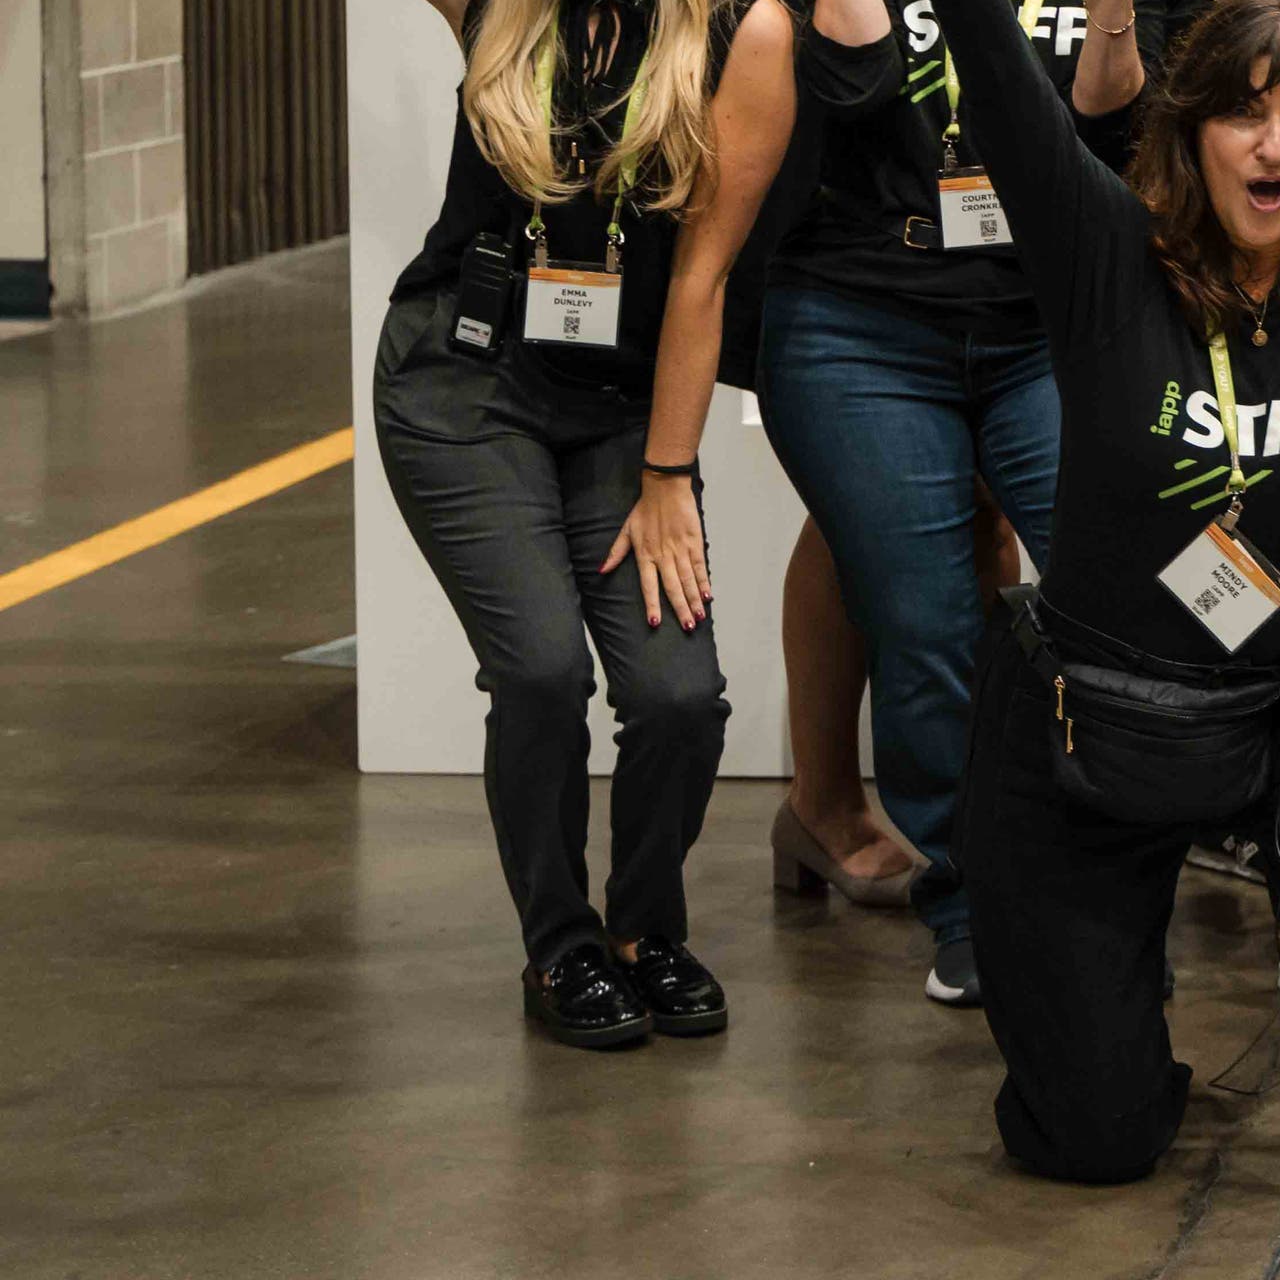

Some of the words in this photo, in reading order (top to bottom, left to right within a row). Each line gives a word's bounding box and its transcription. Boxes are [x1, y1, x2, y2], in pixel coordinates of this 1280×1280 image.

[553, 297, 593, 308] DUNLEVY
[561, 288, 587, 297] EMMA
[1150, 380, 1183, 436] iapp
[1211, 569, 1240, 599] MOORE
[1219, 562, 1248, 591] MINDY
